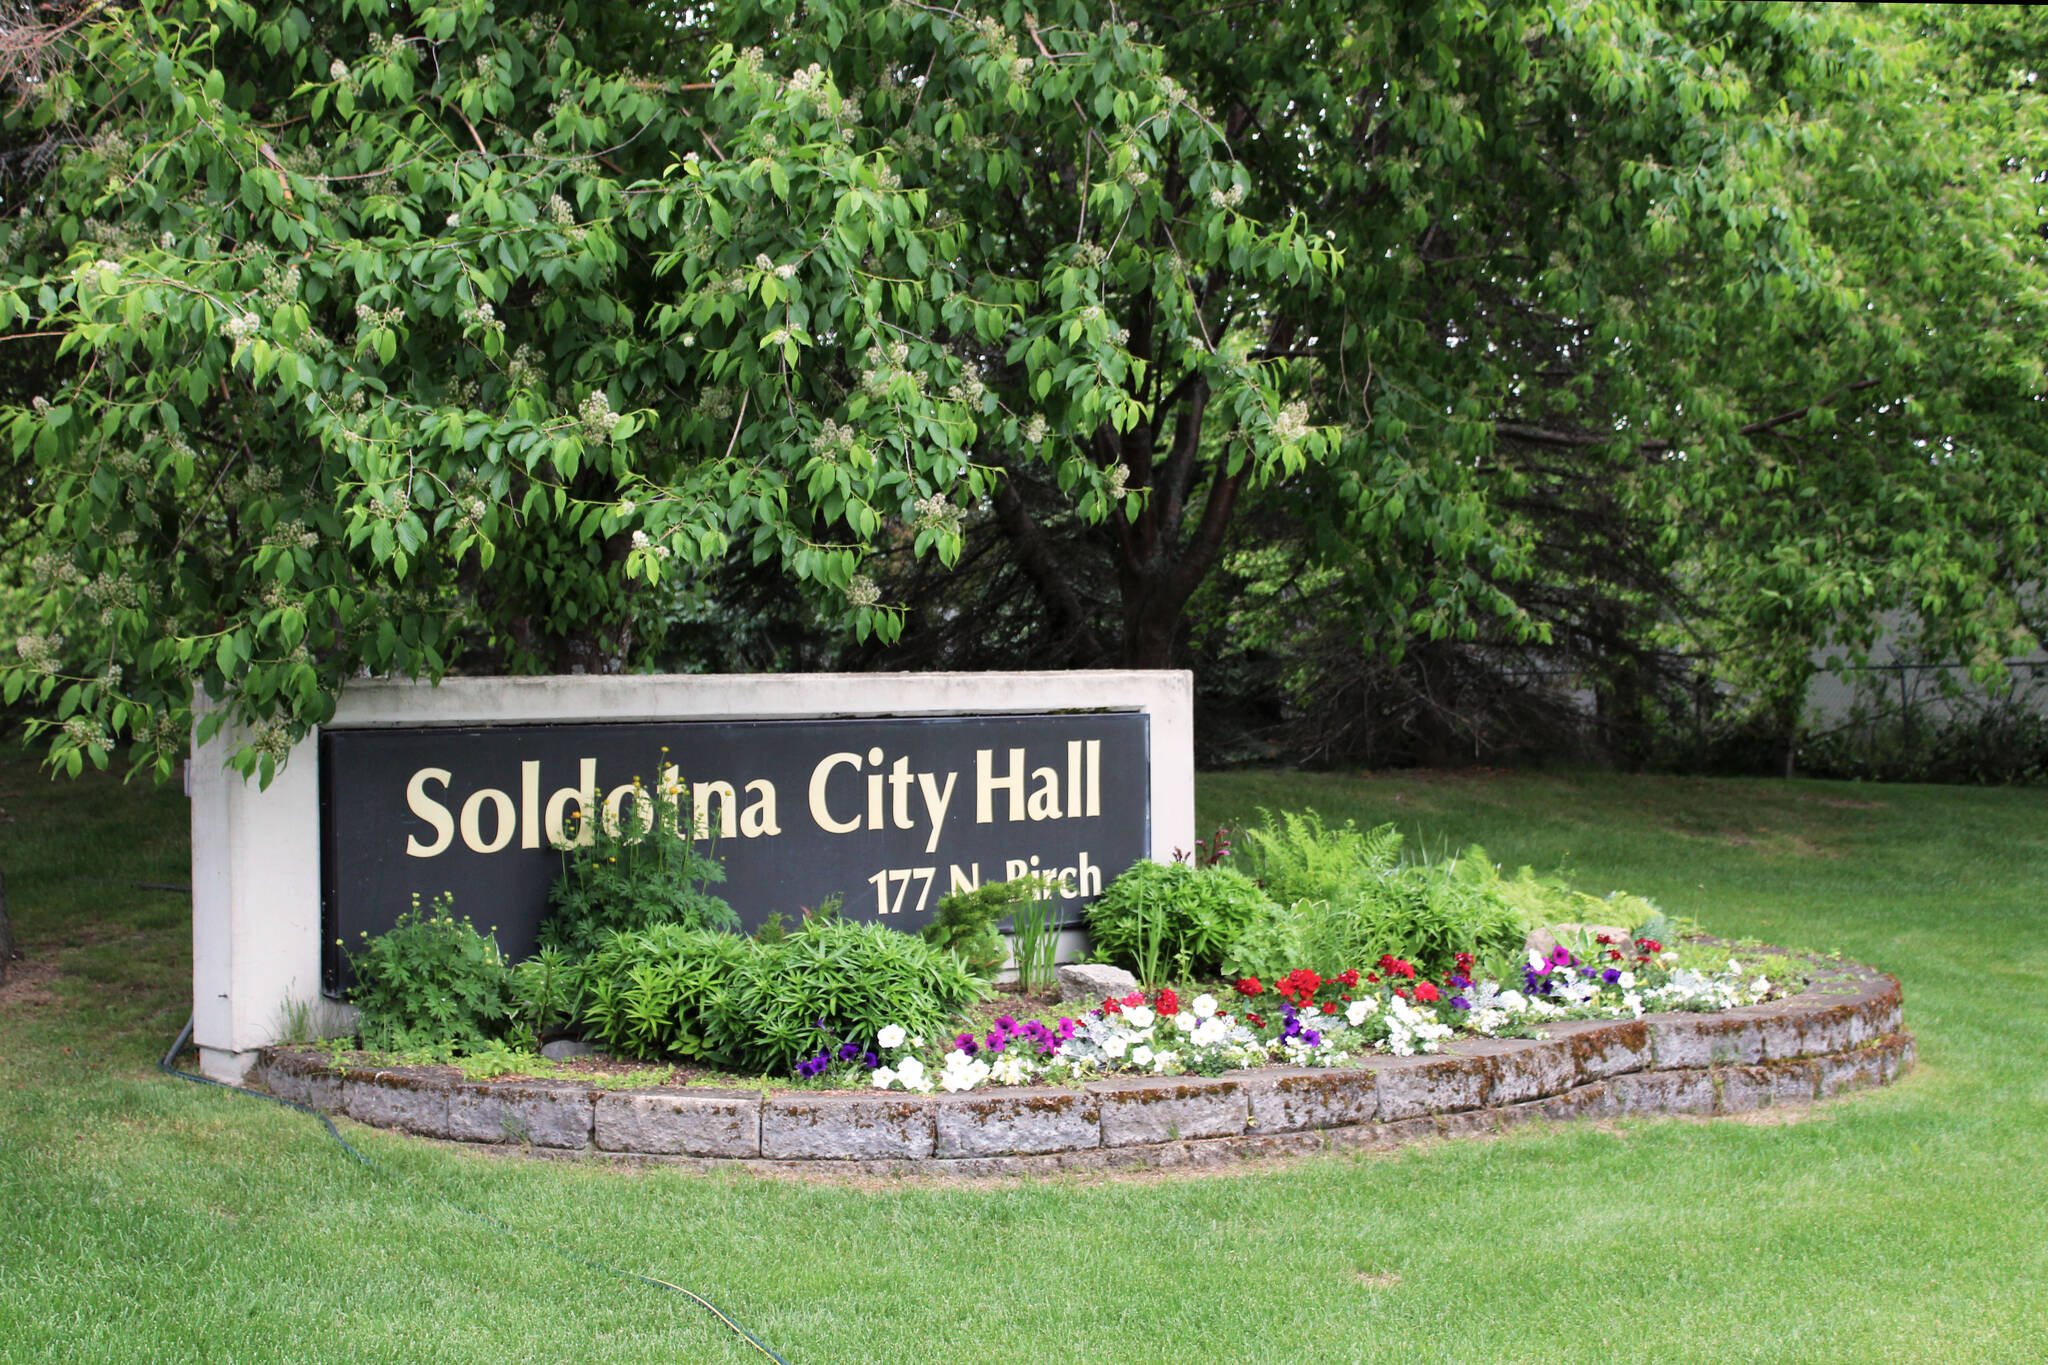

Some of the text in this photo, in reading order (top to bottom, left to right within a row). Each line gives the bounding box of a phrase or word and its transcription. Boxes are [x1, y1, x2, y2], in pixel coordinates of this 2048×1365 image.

[406, 739, 1101, 858] Soldotna City Hall
[868, 867, 936, 914] 177
